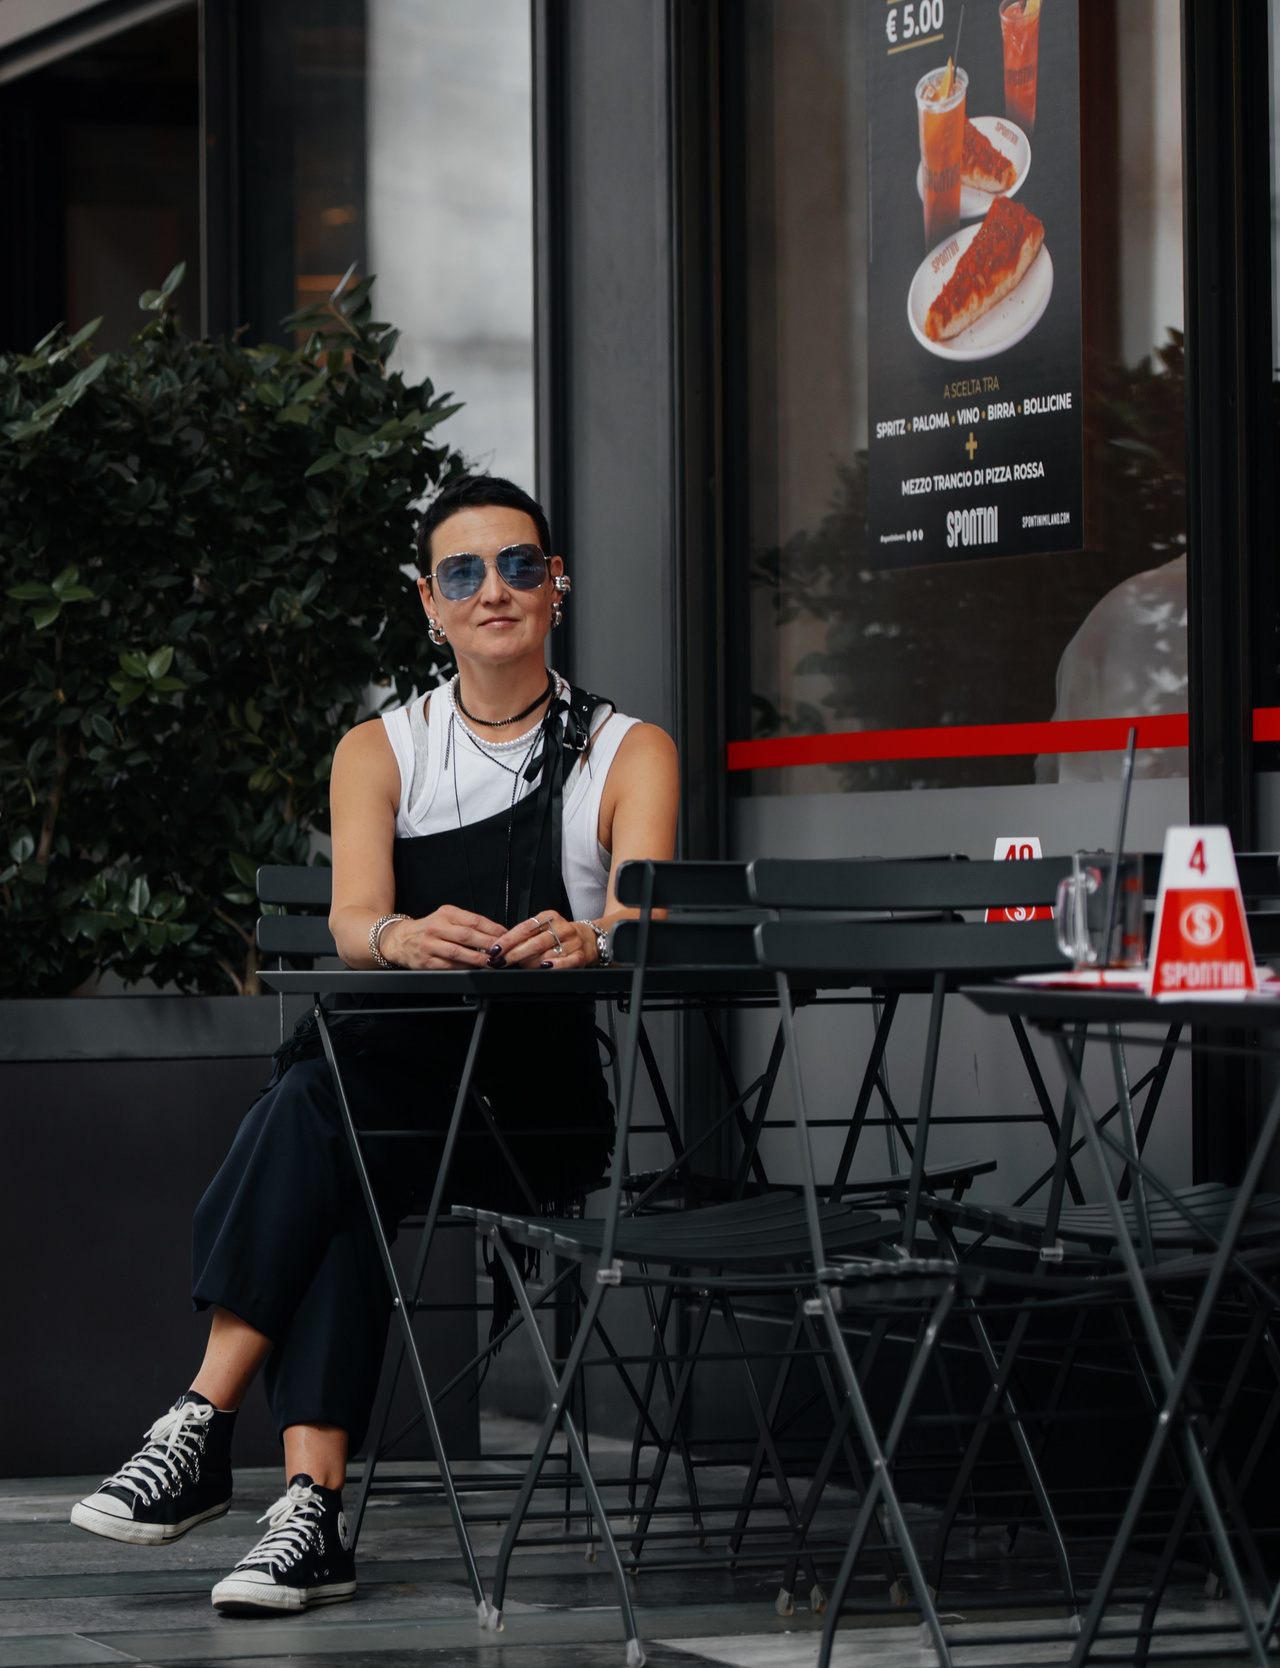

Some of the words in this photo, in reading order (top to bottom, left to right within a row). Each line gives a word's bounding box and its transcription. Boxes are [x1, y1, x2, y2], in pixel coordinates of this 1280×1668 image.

[885, 8, 898, 43] €
[902, 0, 944, 39] 5.00
[931, 239, 960, 274] SPONTINI
[943, 384, 951, 400] A
[951, 379, 982, 398] SCELTA
[983, 376, 1000, 393] TRA
[876, 418, 906, 439] SPRITZ
[913, 411, 950, 433] PALOMA
[957, 406, 980, 425] VINO
[987, 401, 1016, 421] BIRRA
[1023, 392, 1072, 416] BOLLICINE
[901, 476, 932, 496] MEZZO
[932, 470, 973, 491] TRANCIO
[974, 469, 984, 486] DI
[985, 465, 1013, 484] PIZZA
[1013, 461, 1045, 481] ROSSA
[946, 505, 999, 548] SPONTINI
[1188, 838, 1207, 876] 4
[1160, 960, 1246, 988] SPONTINI
